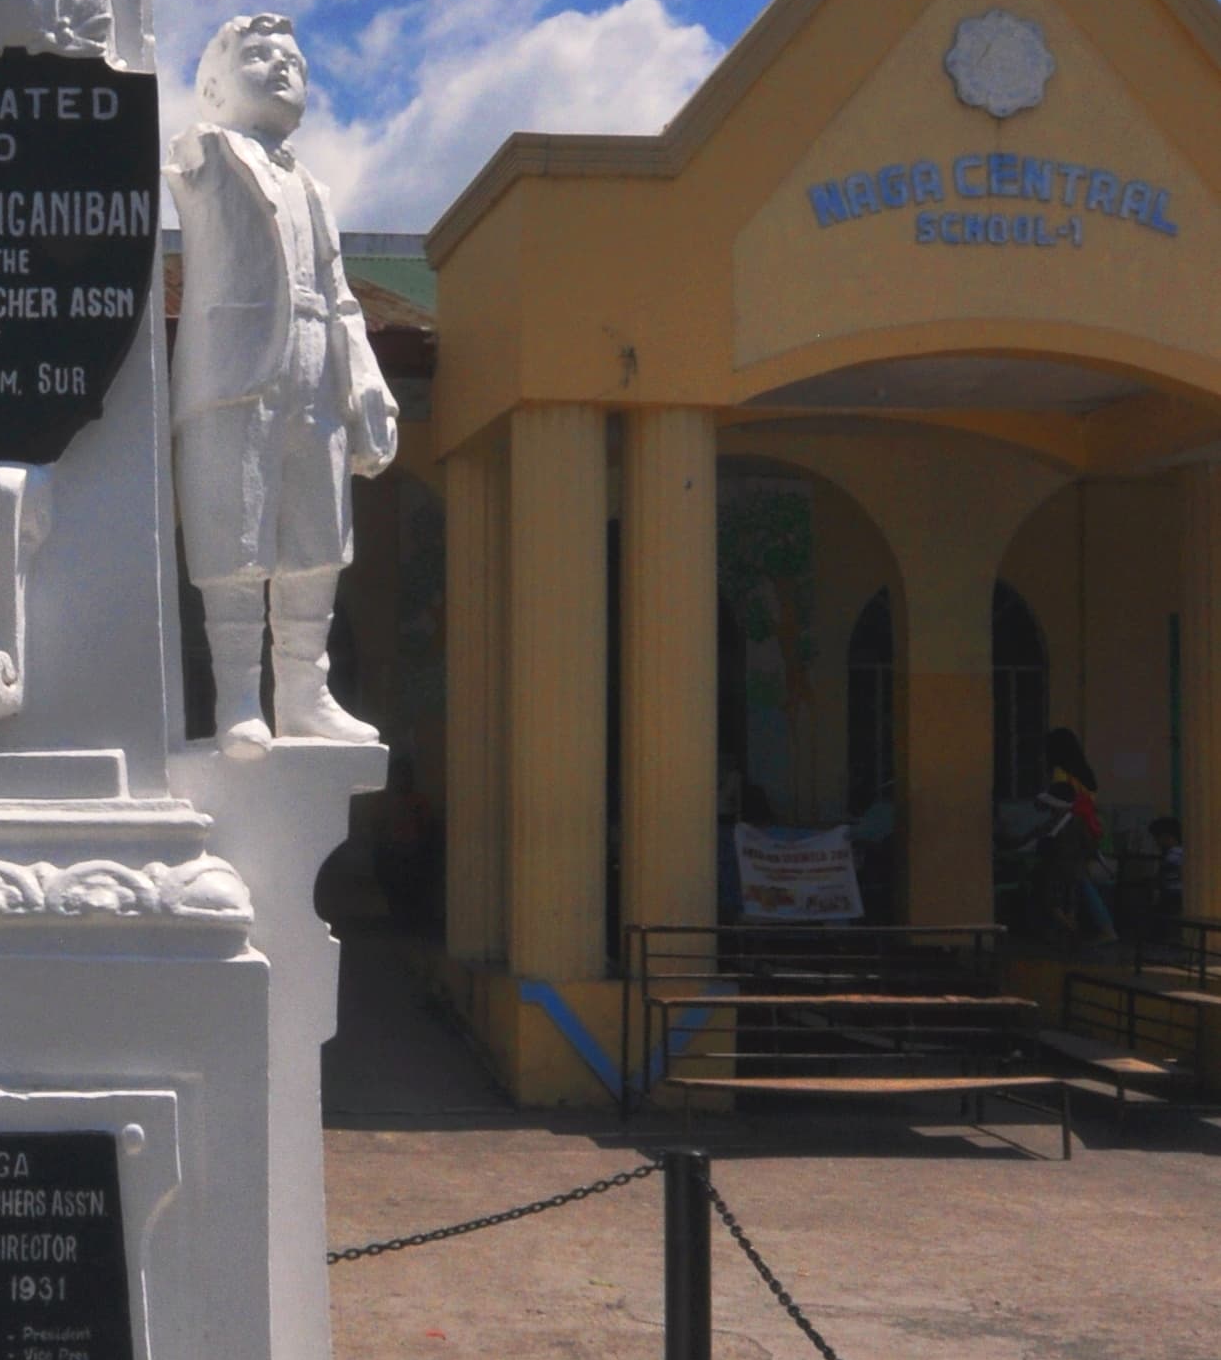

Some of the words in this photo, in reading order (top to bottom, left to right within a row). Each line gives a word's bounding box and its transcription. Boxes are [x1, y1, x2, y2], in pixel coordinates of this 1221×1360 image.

[808, 161, 945, 228] NAGA
[954, 153, 1179, 237] CENTRAL
[70, 288, 134, 318] ASSN
[38, 365, 85, 395] SUR
[11, 1275, 66, 1303] 1931
